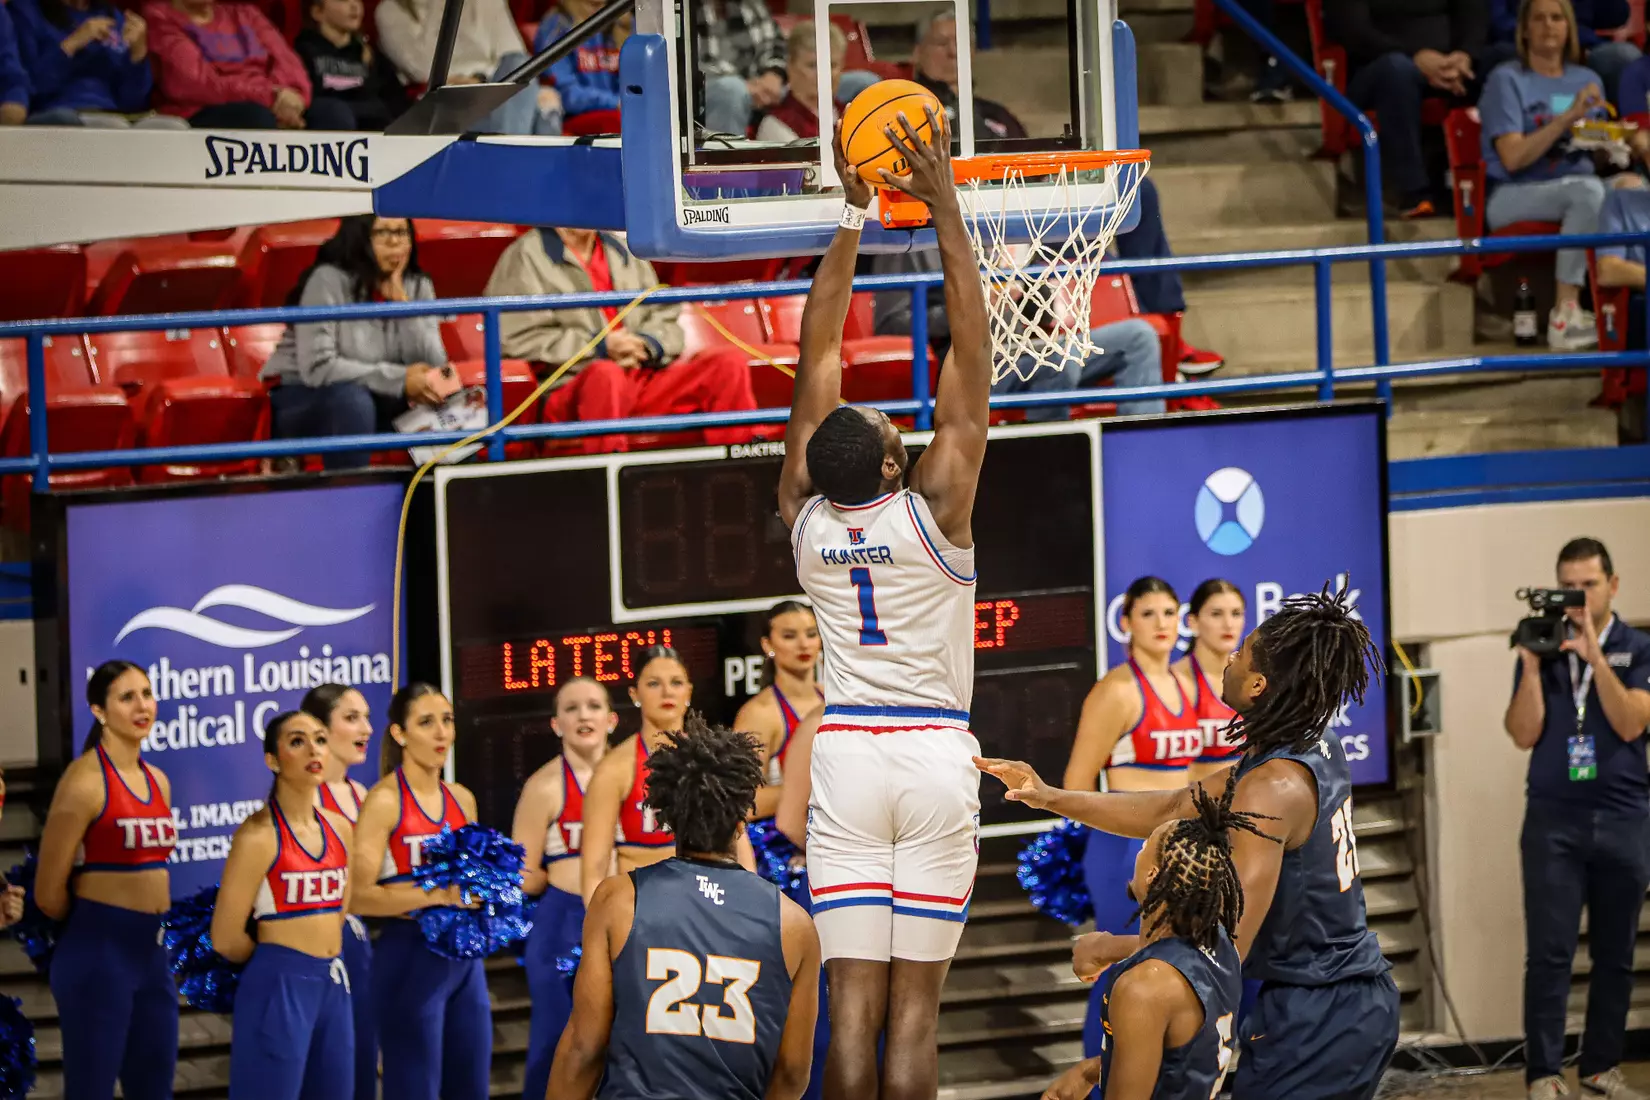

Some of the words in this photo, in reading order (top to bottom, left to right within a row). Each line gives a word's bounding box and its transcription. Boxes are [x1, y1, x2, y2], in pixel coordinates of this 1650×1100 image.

[205, 135, 369, 183] SPALDING
[683, 206, 729, 226] SPALDING
[821, 545, 895, 565] HUNTER
[849, 567, 888, 646] 1
[244, 644, 392, 694] Louisiana
[140, 700, 246, 752] edical
[645, 947, 761, 1045] 23
